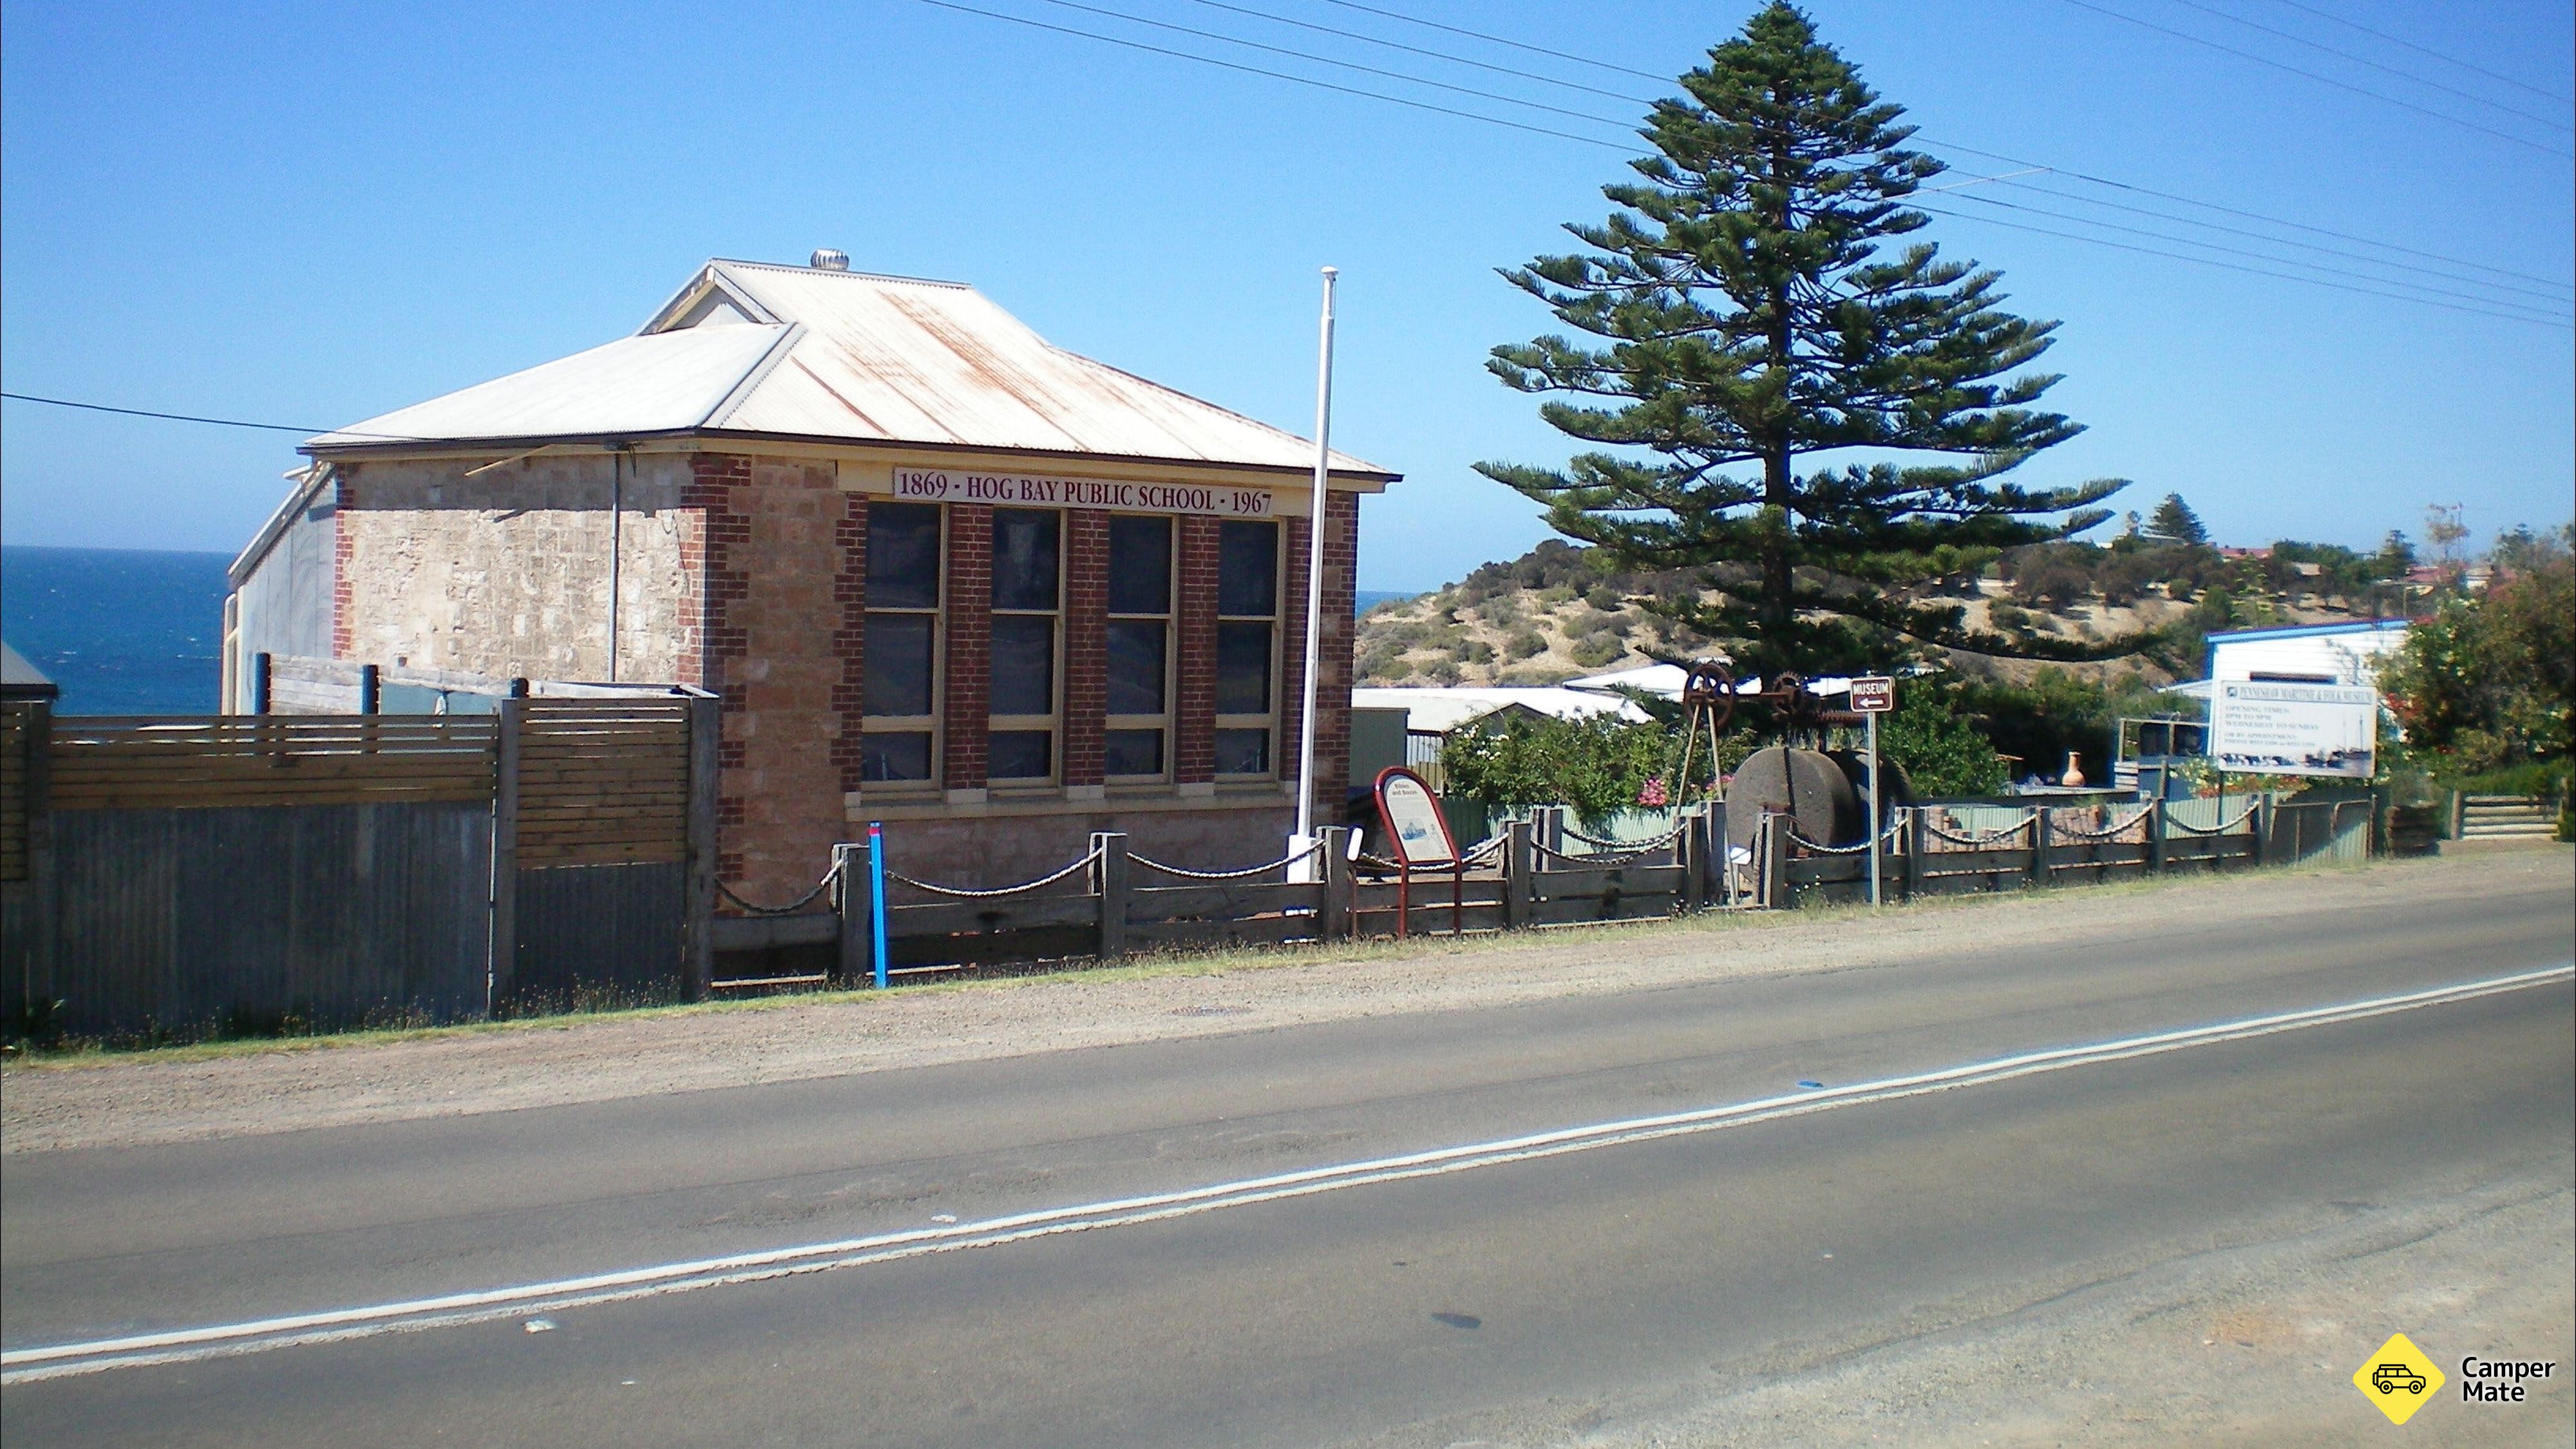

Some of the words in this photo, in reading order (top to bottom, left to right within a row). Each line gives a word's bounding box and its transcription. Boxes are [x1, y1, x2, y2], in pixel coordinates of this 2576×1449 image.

[900, 471, 947, 498] 1869
[967, 476, 1013, 500] HOG
[1021, 479, 1058, 501] BAY
[1064, 481, 1132, 504] PUBLIC
[1138, 486, 1215, 511] SCHOOL
[1232, 490, 1272, 514] 1967
[1853, 683, 1889, 695] MUSEUM
